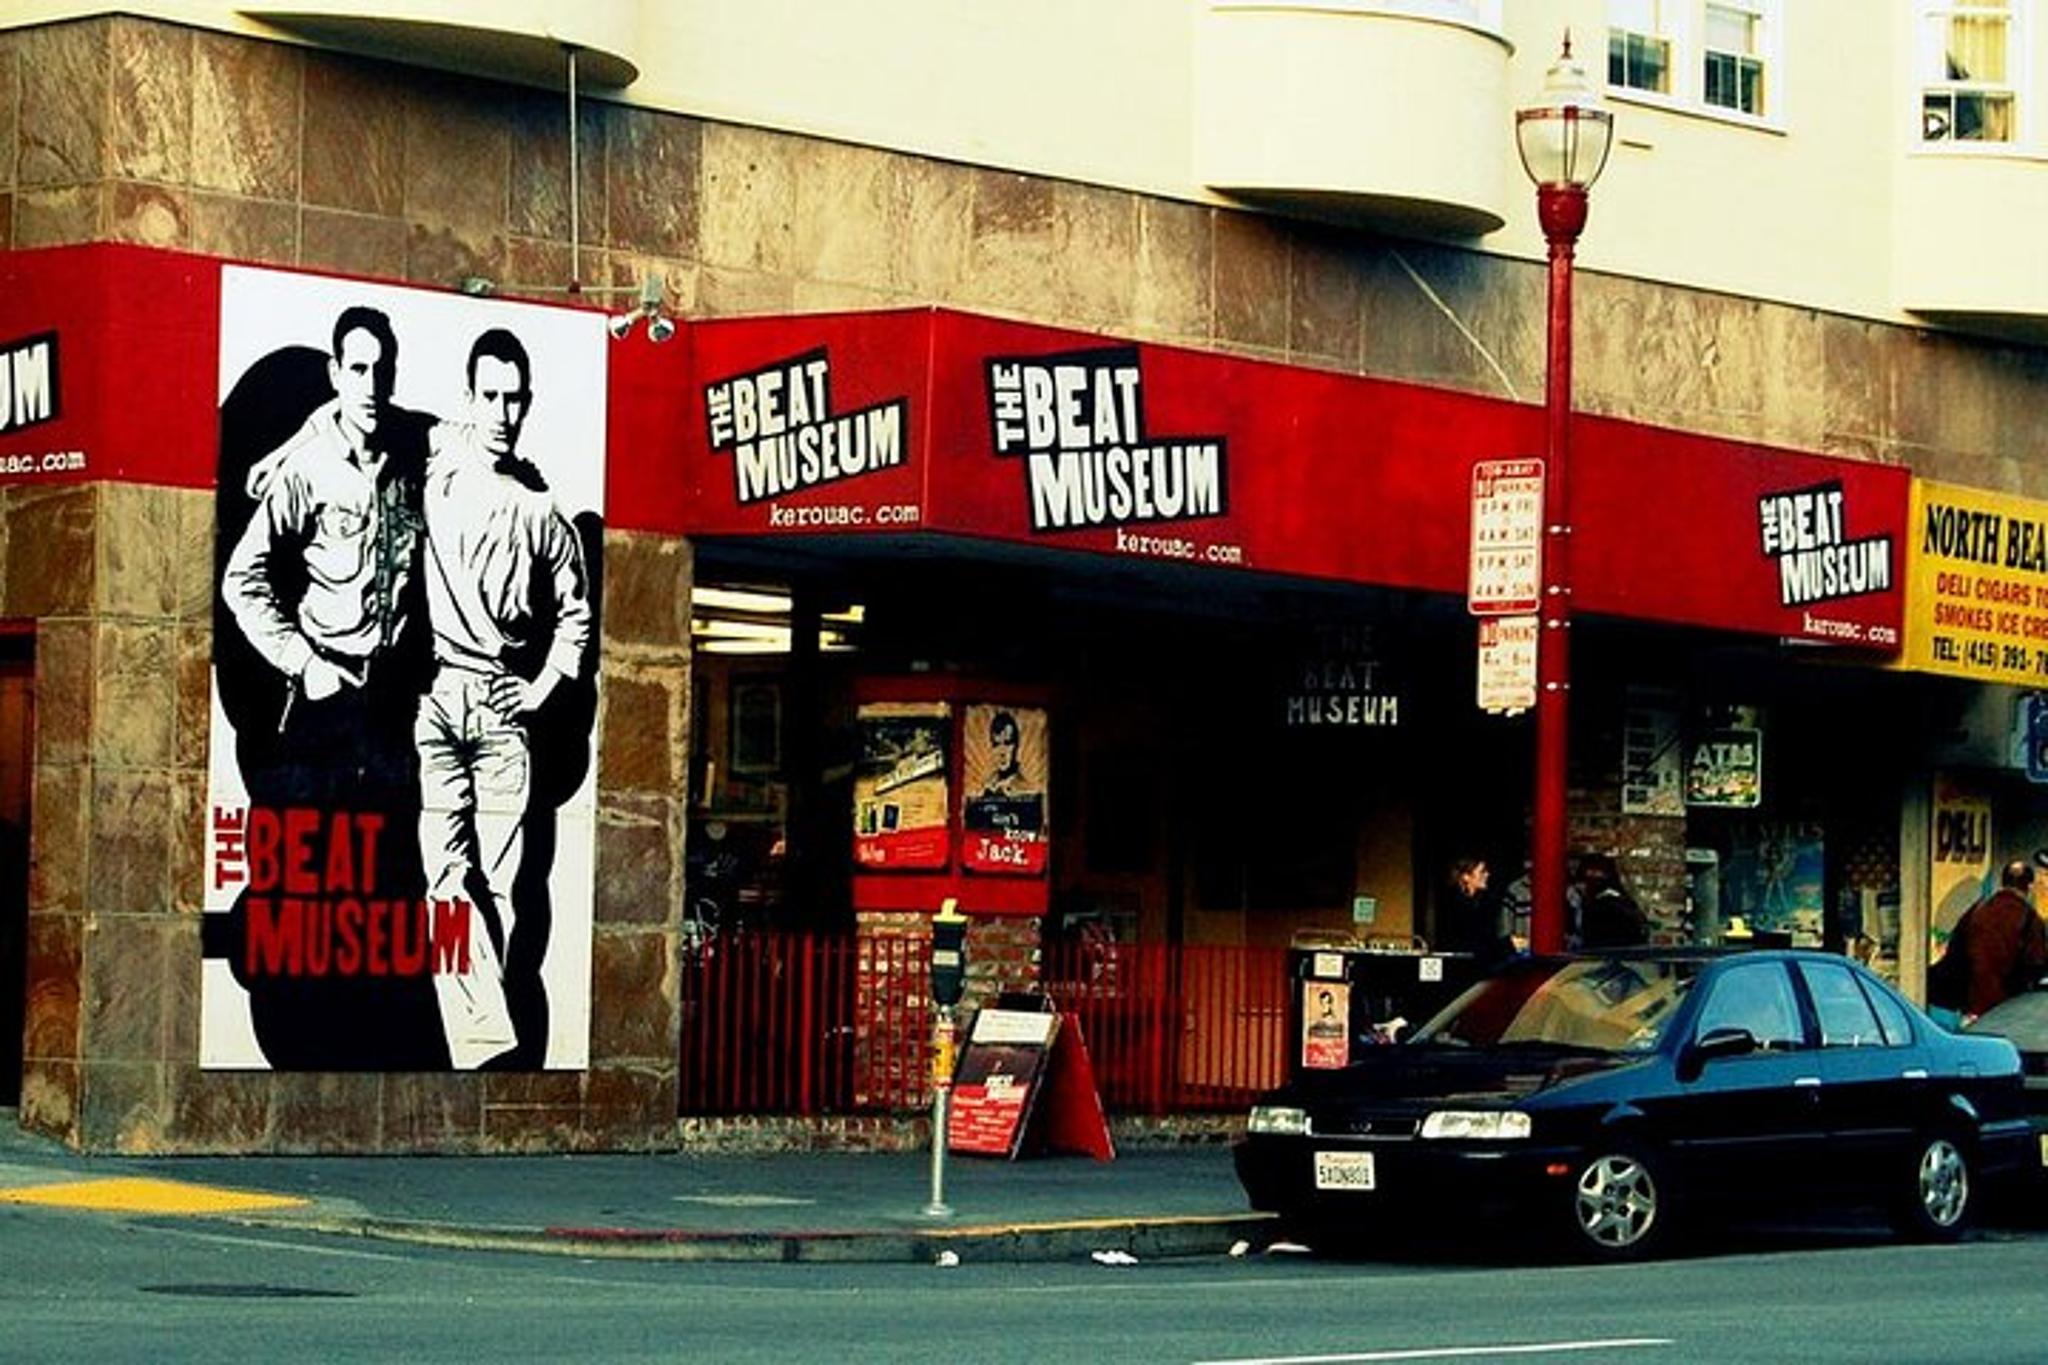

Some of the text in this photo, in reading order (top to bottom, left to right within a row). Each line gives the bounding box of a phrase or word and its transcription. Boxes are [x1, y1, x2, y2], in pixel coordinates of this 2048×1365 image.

[707, 383, 734, 448] THE
[732, 359, 828, 442] BEAT
[992, 363, 1026, 451] THE
[1023, 365, 1139, 448] BEAT
[735, 405, 900, 501] MUSEUM
[769, 502, 920, 527] kerouac.com
[1028, 445, 1219, 528] MUSEUM
[1116, 528, 1242, 564] kerouac.com
[1760, 498, 1779, 555] THE
[1777, 491, 1843, 551] BEAT
[1923, 503, 2001, 566] NORTH
[1780, 539, 1889, 604] MUSEUM
[1937, 571, 1971, 598] DELI
[1975, 577, 2032, 607] CIGARS
[1934, 602, 1994, 632] SMOKES
[1997, 611, 2019, 636] ICE
[1933, 636, 1961, 662] TEL:
[1964, 639, 1999, 672] (415)
[1287, 695, 1398, 726] MUSEUM
[1694, 743, 1755, 767] ATM
[213, 806, 244, 890] THE
[249, 808, 387, 894] BEAT
[1935, 809, 1986, 862] DELI
[245, 896, 472, 976] MUSEUM
